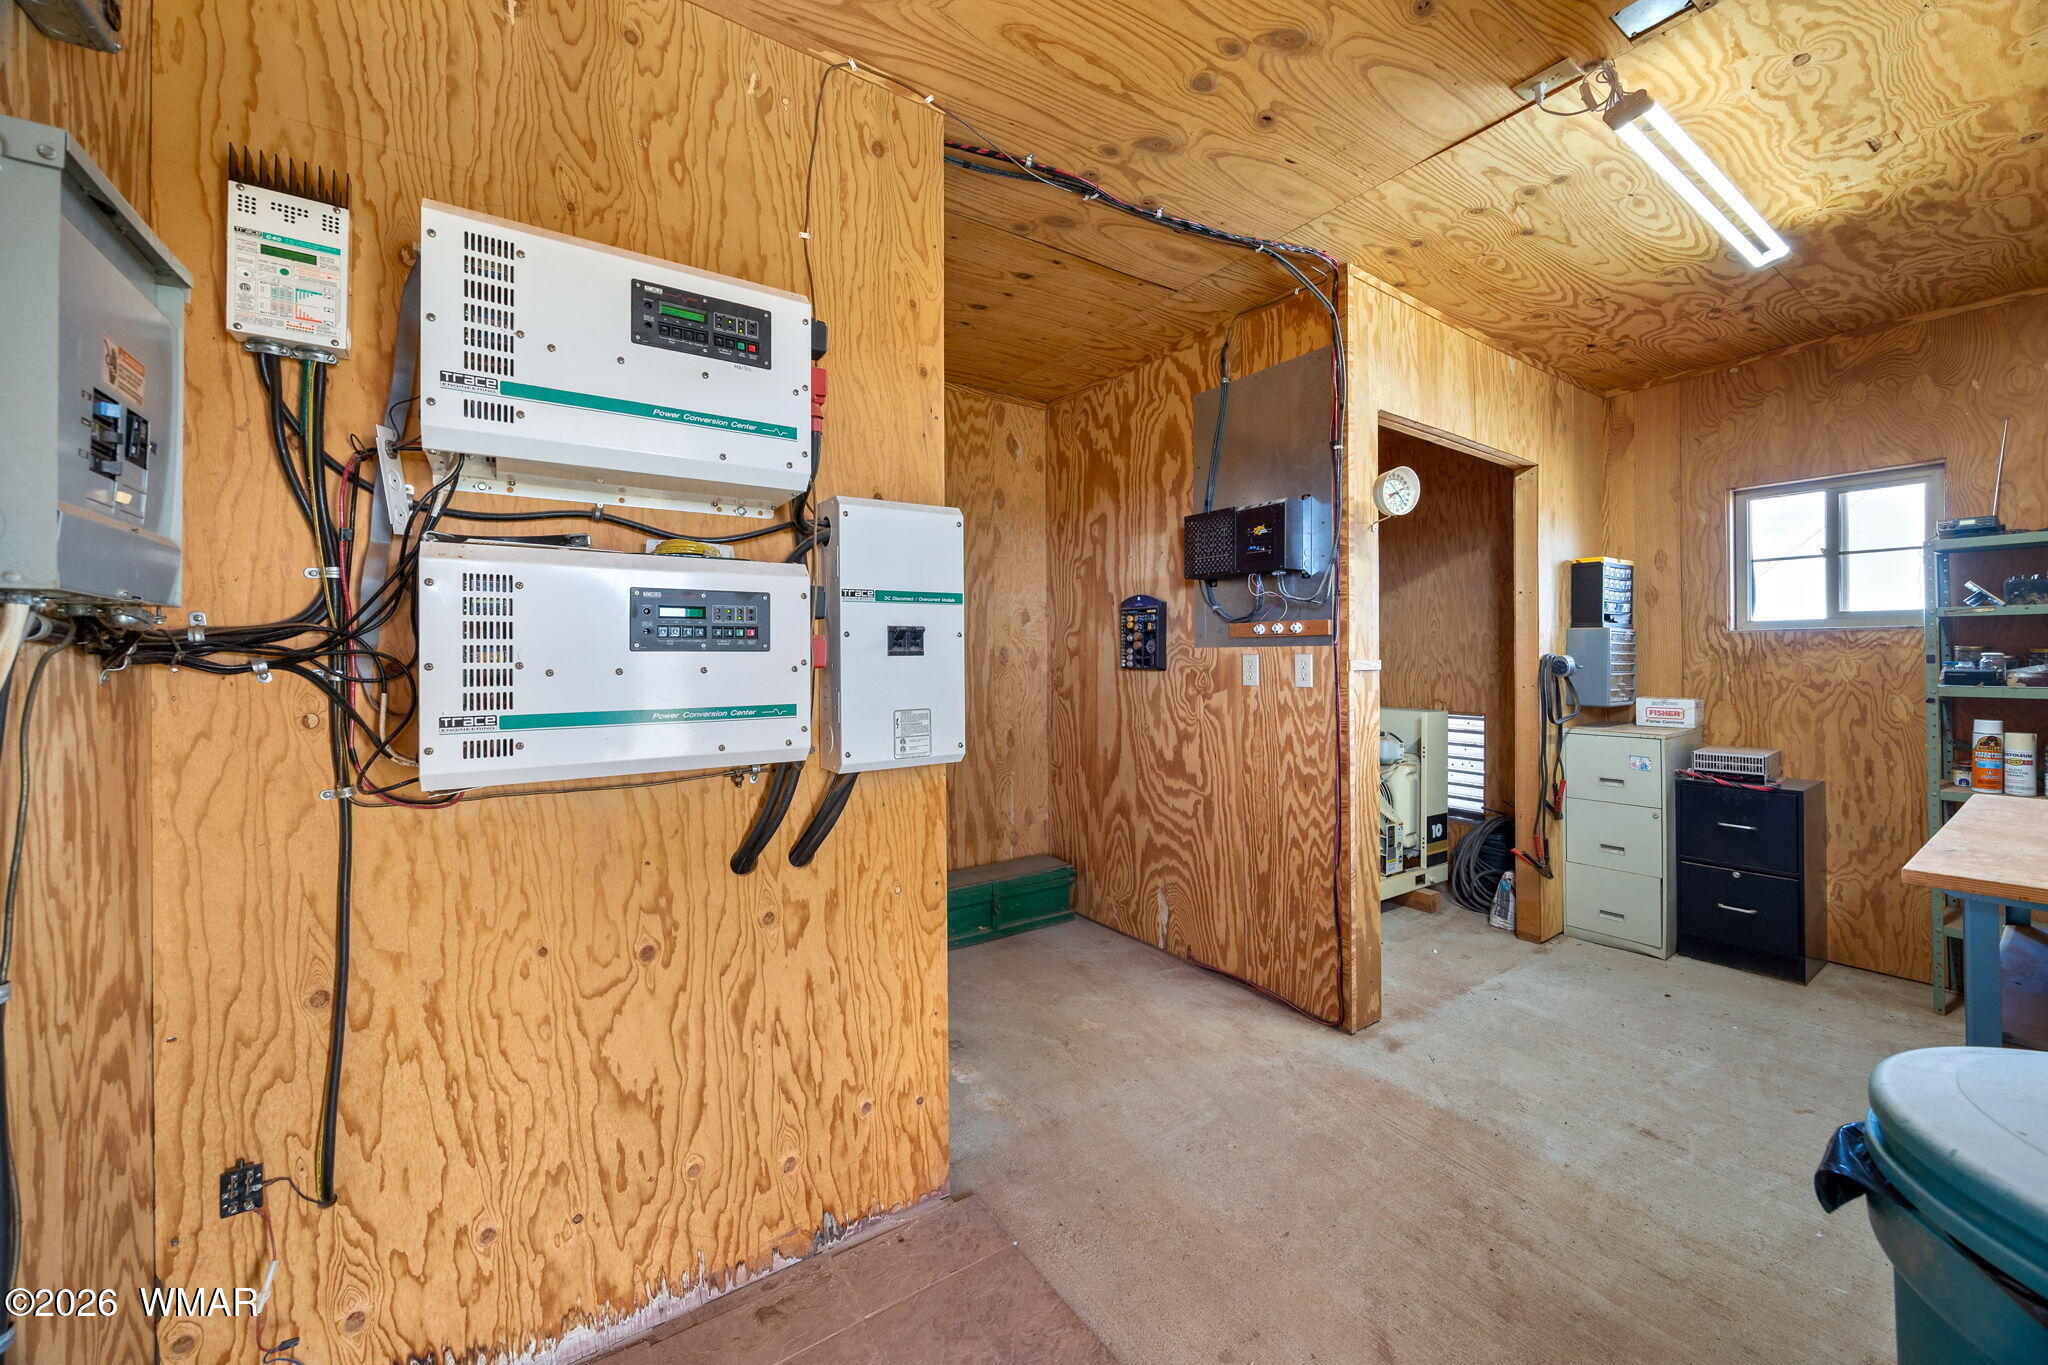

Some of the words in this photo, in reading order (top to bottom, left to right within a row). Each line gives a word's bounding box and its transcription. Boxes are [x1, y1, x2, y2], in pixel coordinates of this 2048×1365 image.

[266, 234, 282, 242] C40
[441, 371, 497, 389] Trace
[653, 409, 680, 419] Power
[683, 413, 728, 426] Conversion
[731, 421, 757, 430] Center
[842, 589, 874, 597] Trace
[682, 710, 728, 719] Conversion
[1649, 709, 1682, 717] FISHER
[440, 716, 496, 727] Trace
[1431, 824, 1443, 838] 10
